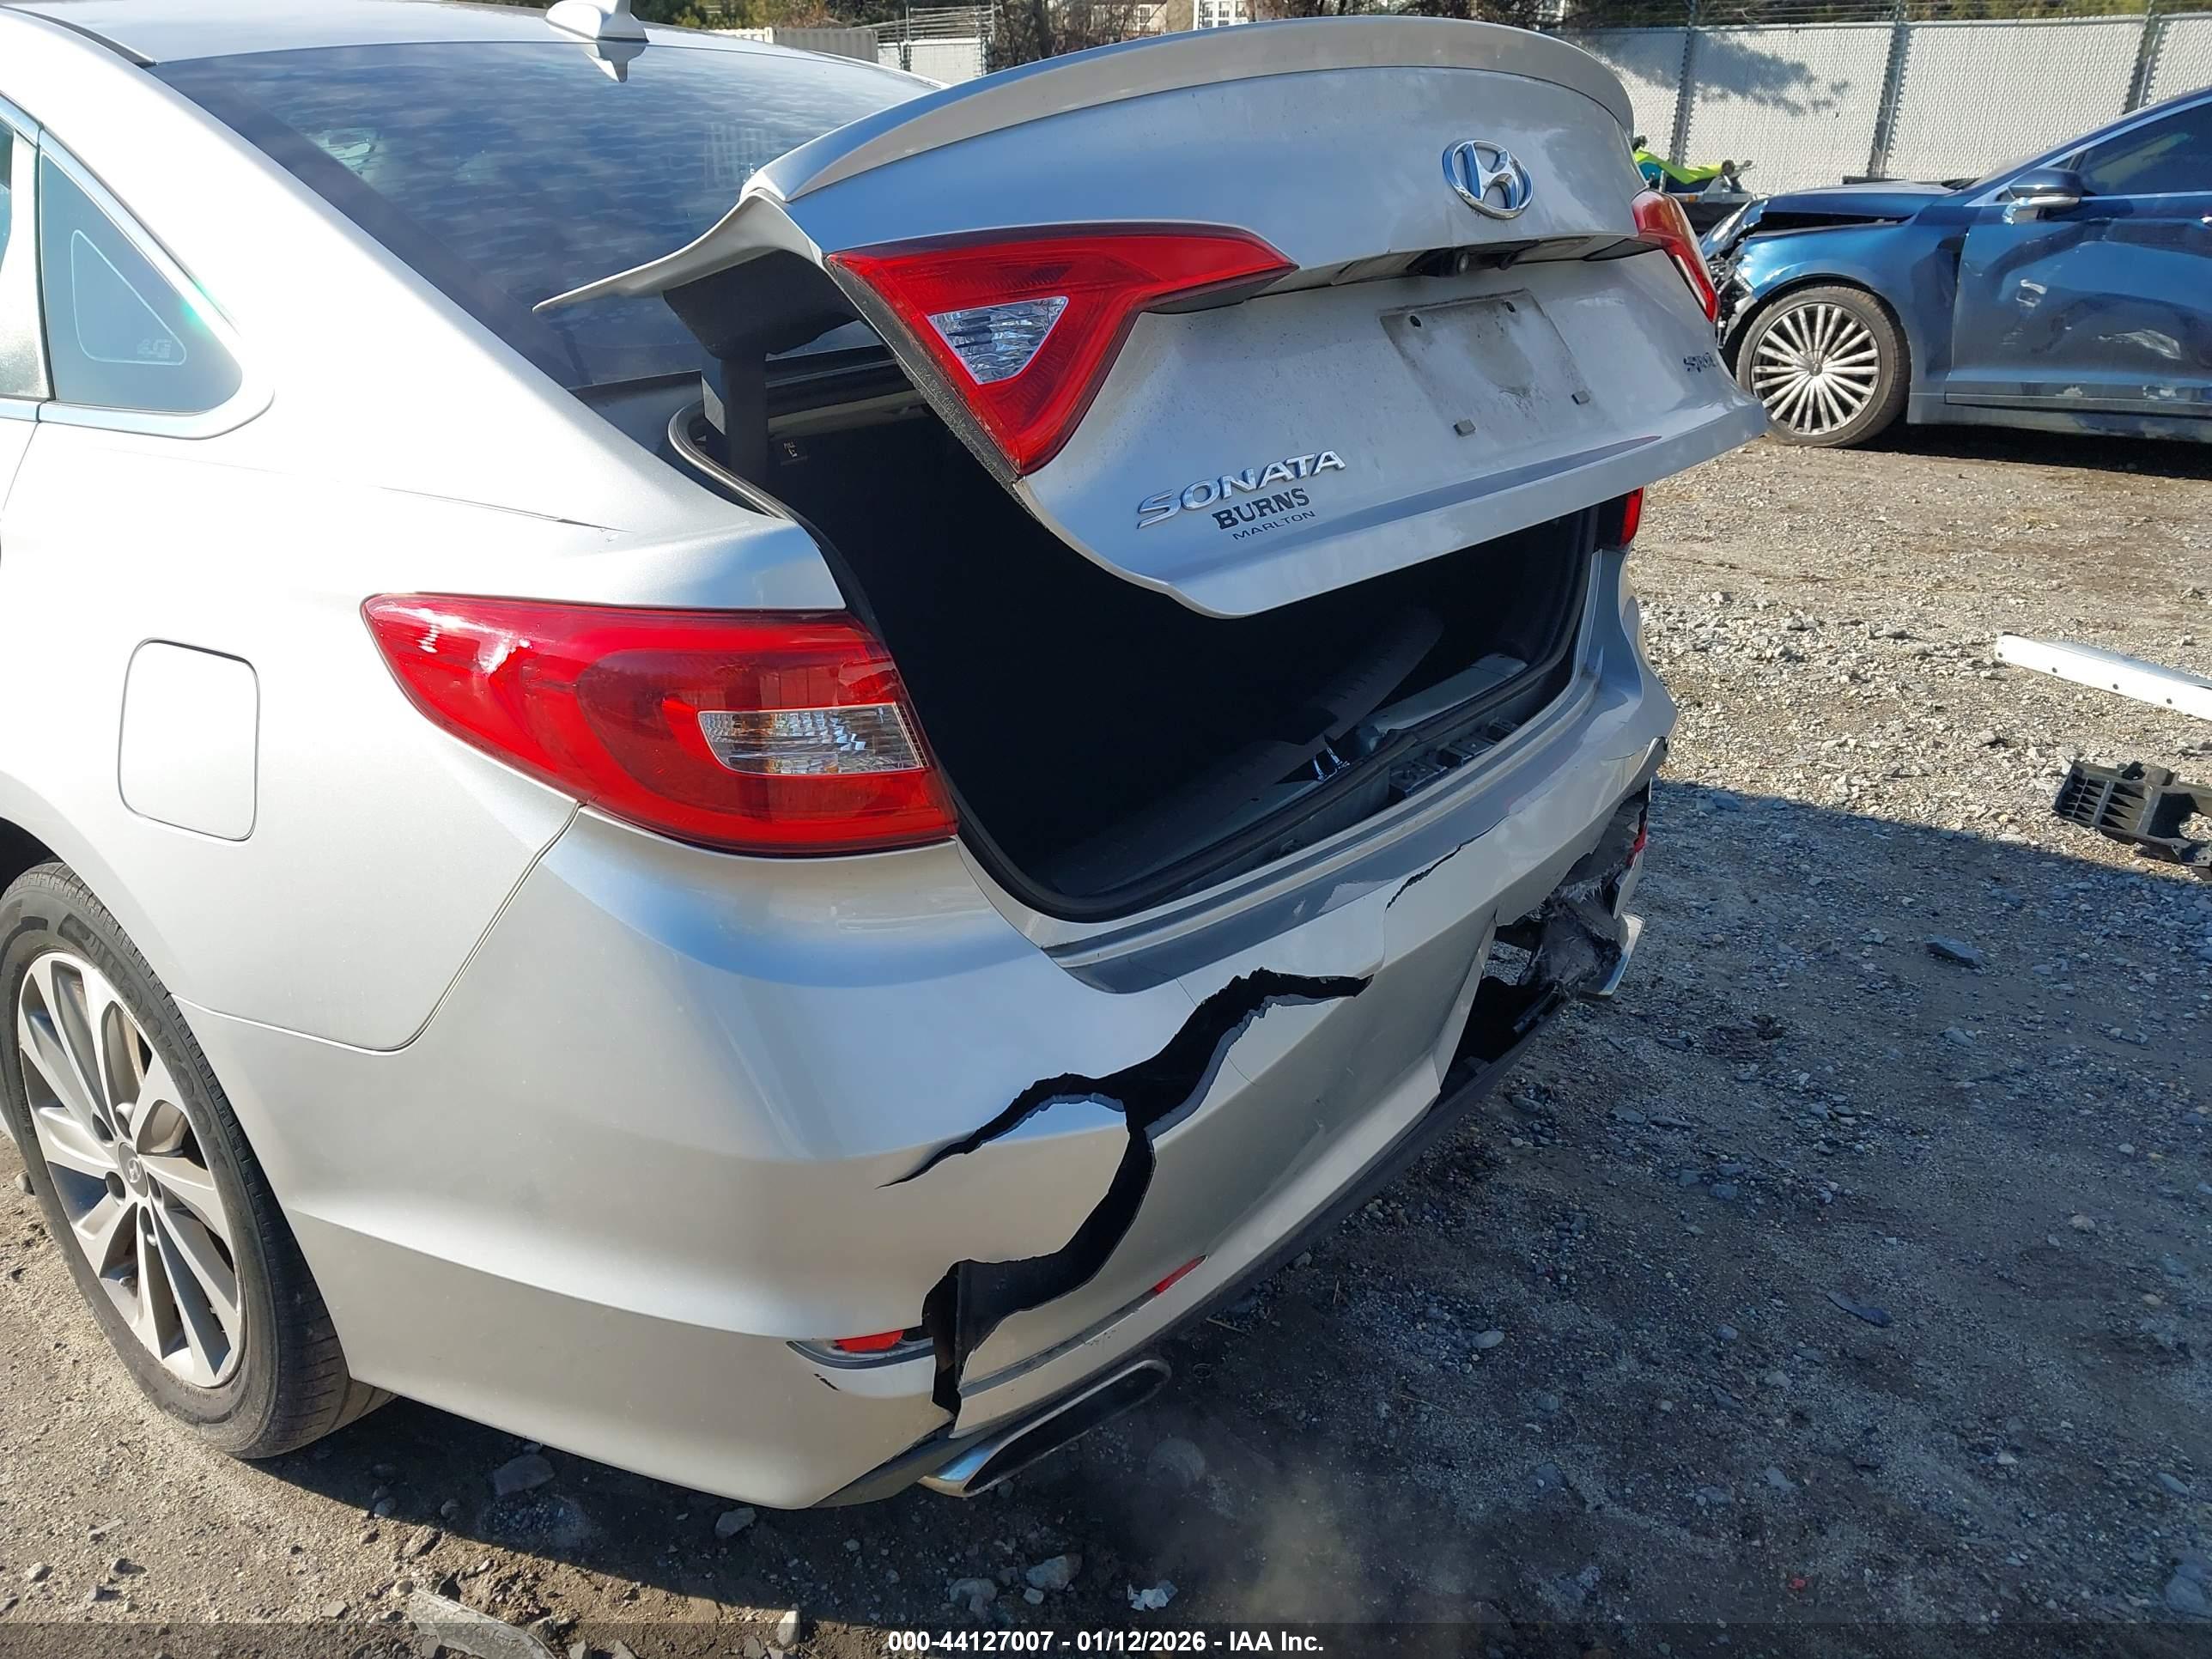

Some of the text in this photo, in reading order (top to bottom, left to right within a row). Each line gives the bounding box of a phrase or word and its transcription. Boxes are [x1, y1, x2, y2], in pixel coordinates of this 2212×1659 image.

[1137, 450, 1346, 529] SONATA
[1212, 487, 1310, 530] BURNS
[1232, 510, 1316, 540] MARLTON
